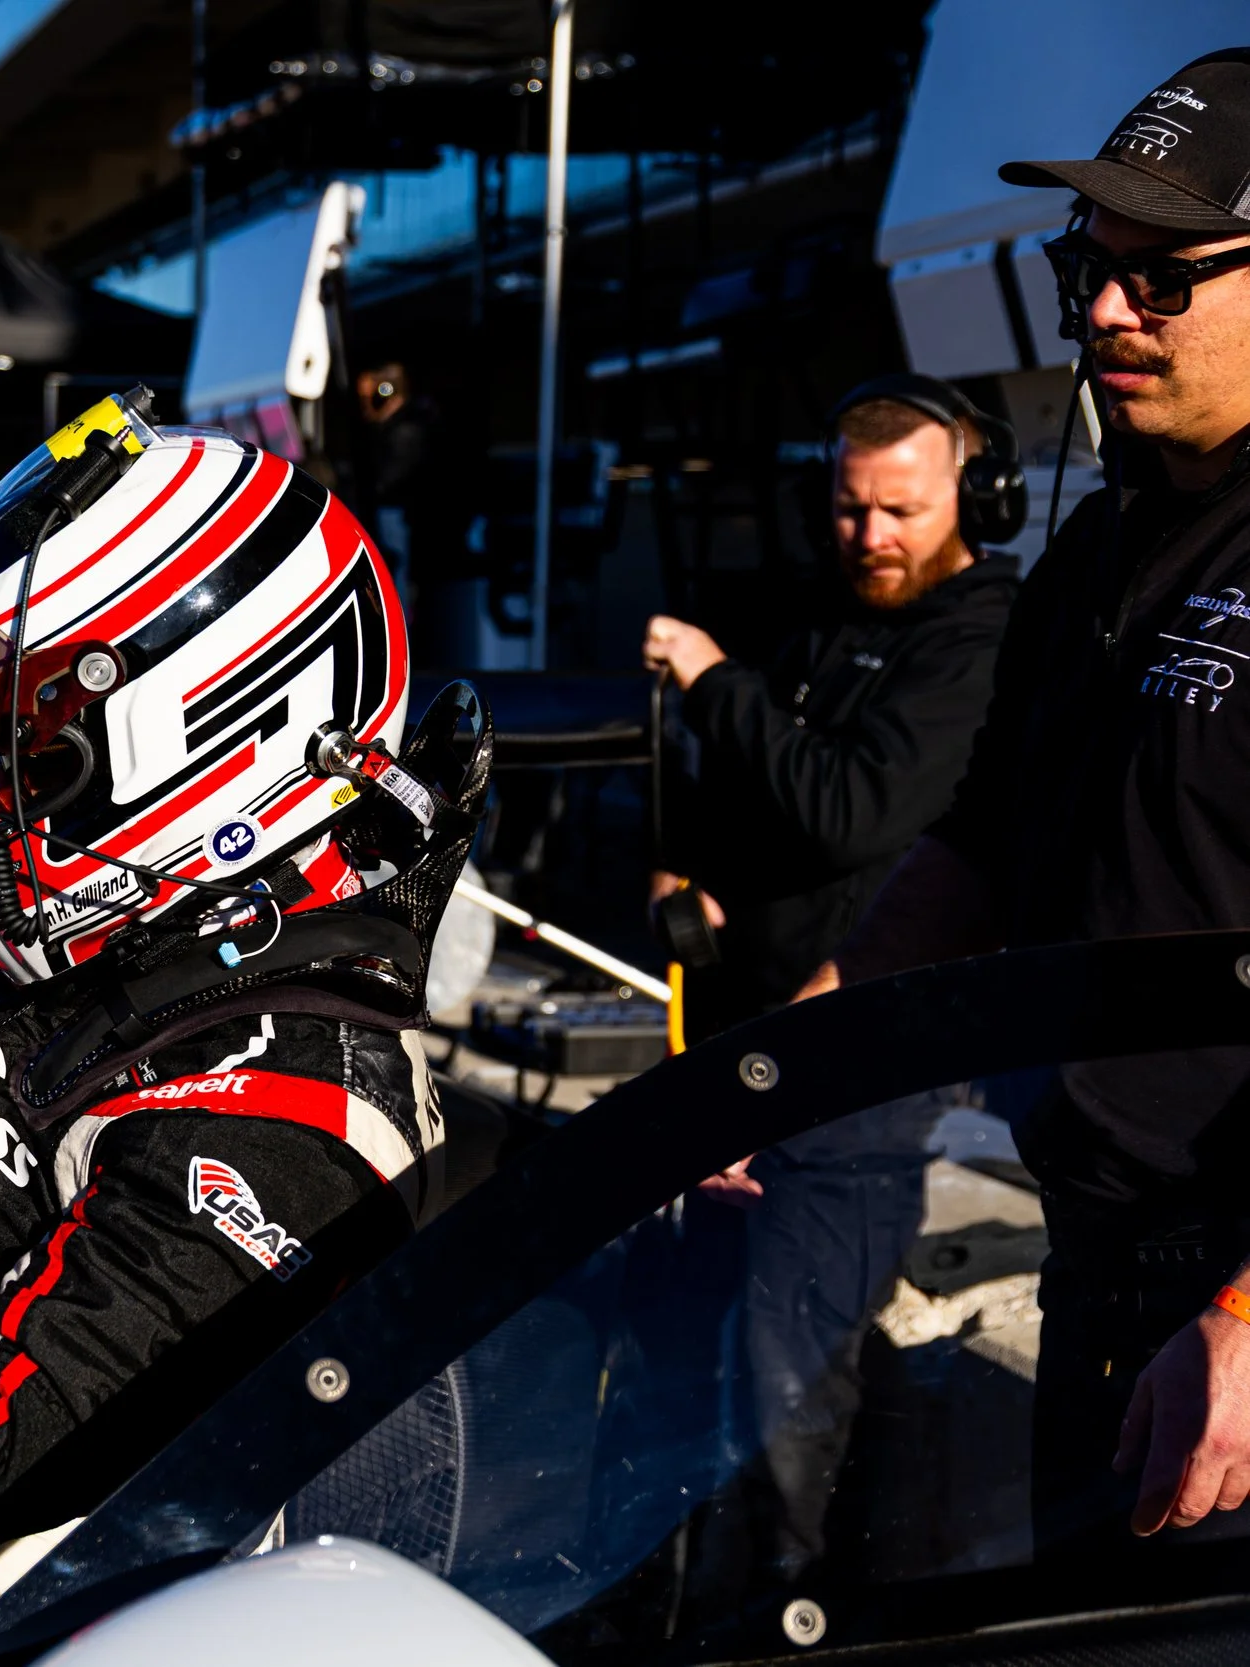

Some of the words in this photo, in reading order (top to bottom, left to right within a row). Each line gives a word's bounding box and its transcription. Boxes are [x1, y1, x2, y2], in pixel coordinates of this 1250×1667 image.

[1110, 137, 1168, 160] RILEY
[1185, 593, 1250, 620] KELLYMOS
[1140, 676, 1223, 712] RILEY
[219, 826, 252, 854] 42
[54, 899, 71, 921] H.
[72, 868, 128, 913] Gilliland
[204, 1188, 308, 1270] USAC
[1137, 1248, 1205, 1264] RILE
